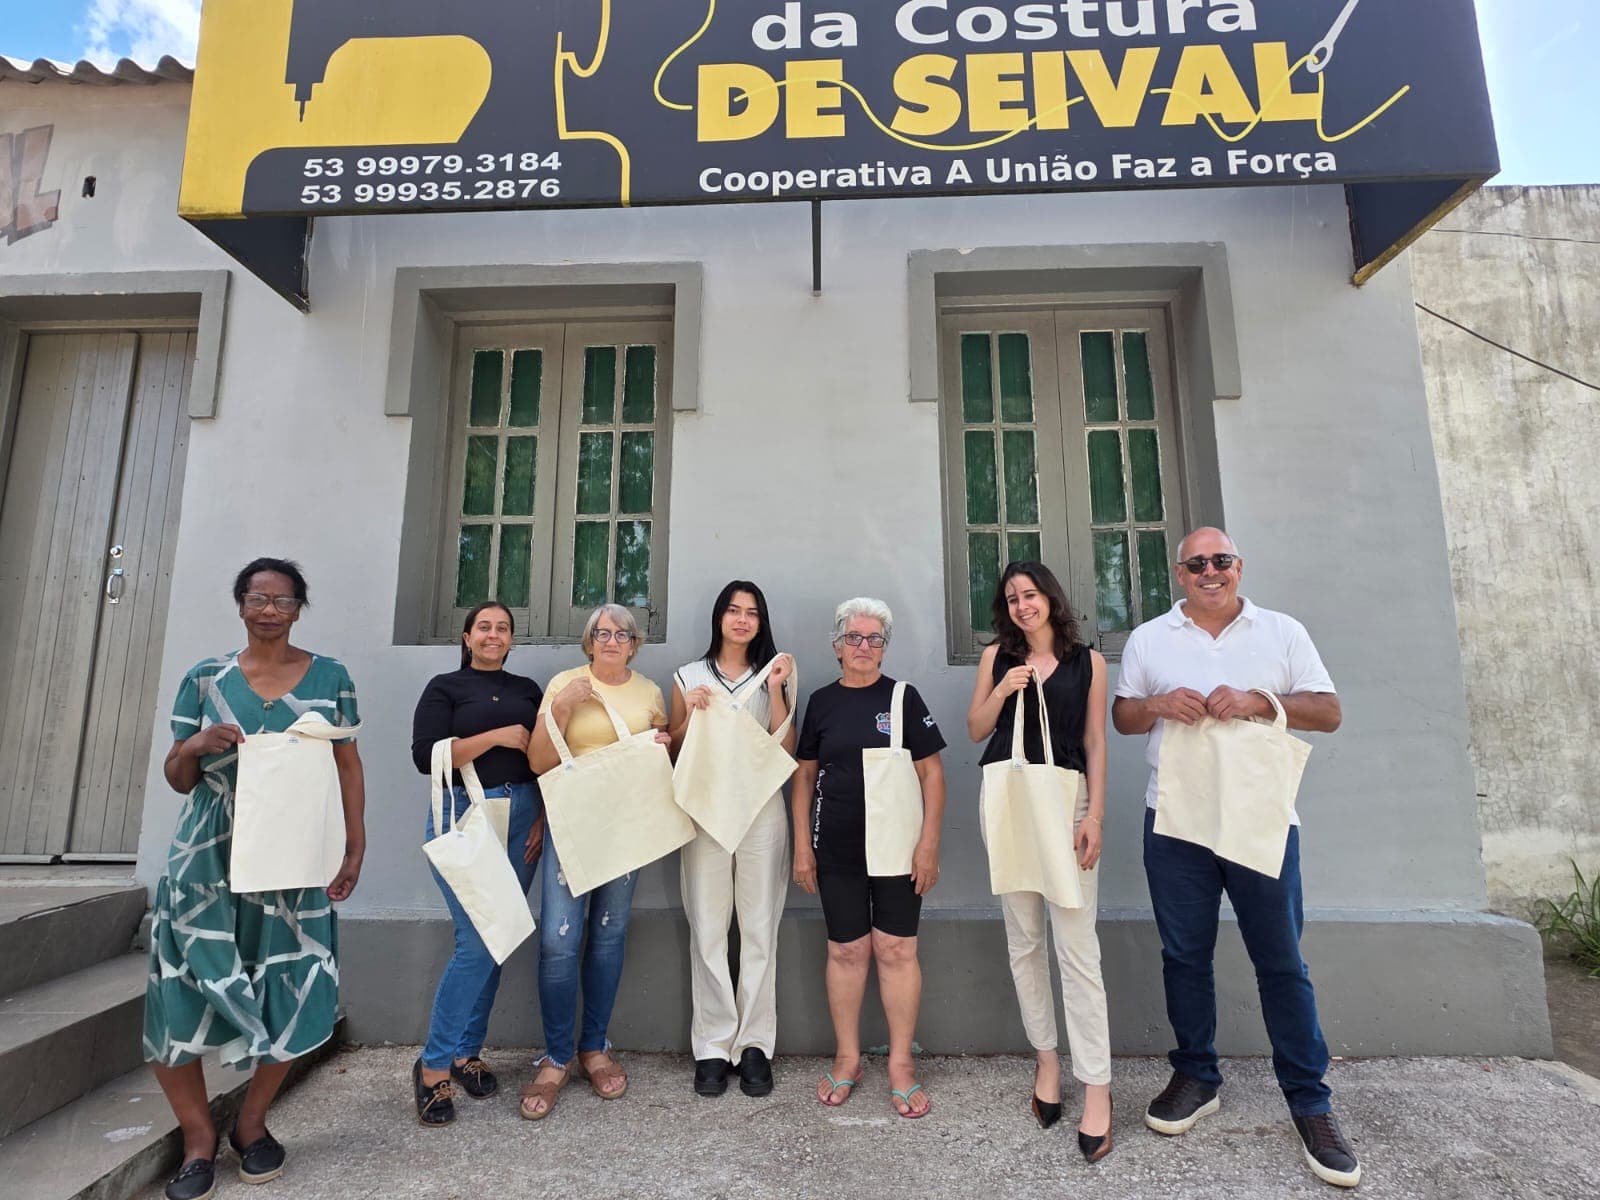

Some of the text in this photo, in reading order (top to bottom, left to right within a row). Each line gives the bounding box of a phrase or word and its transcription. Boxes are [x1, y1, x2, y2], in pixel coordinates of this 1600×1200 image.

[751, 0, 1257, 51] da Costura
[697, 41, 1324, 142] DE SEIVAL
[303, 152, 563, 178] 53 99979.3184
[698, 149, 1337, 197] Cooperativa A União Faz a Força
[300, 178, 562, 205] 53 99935.2876
